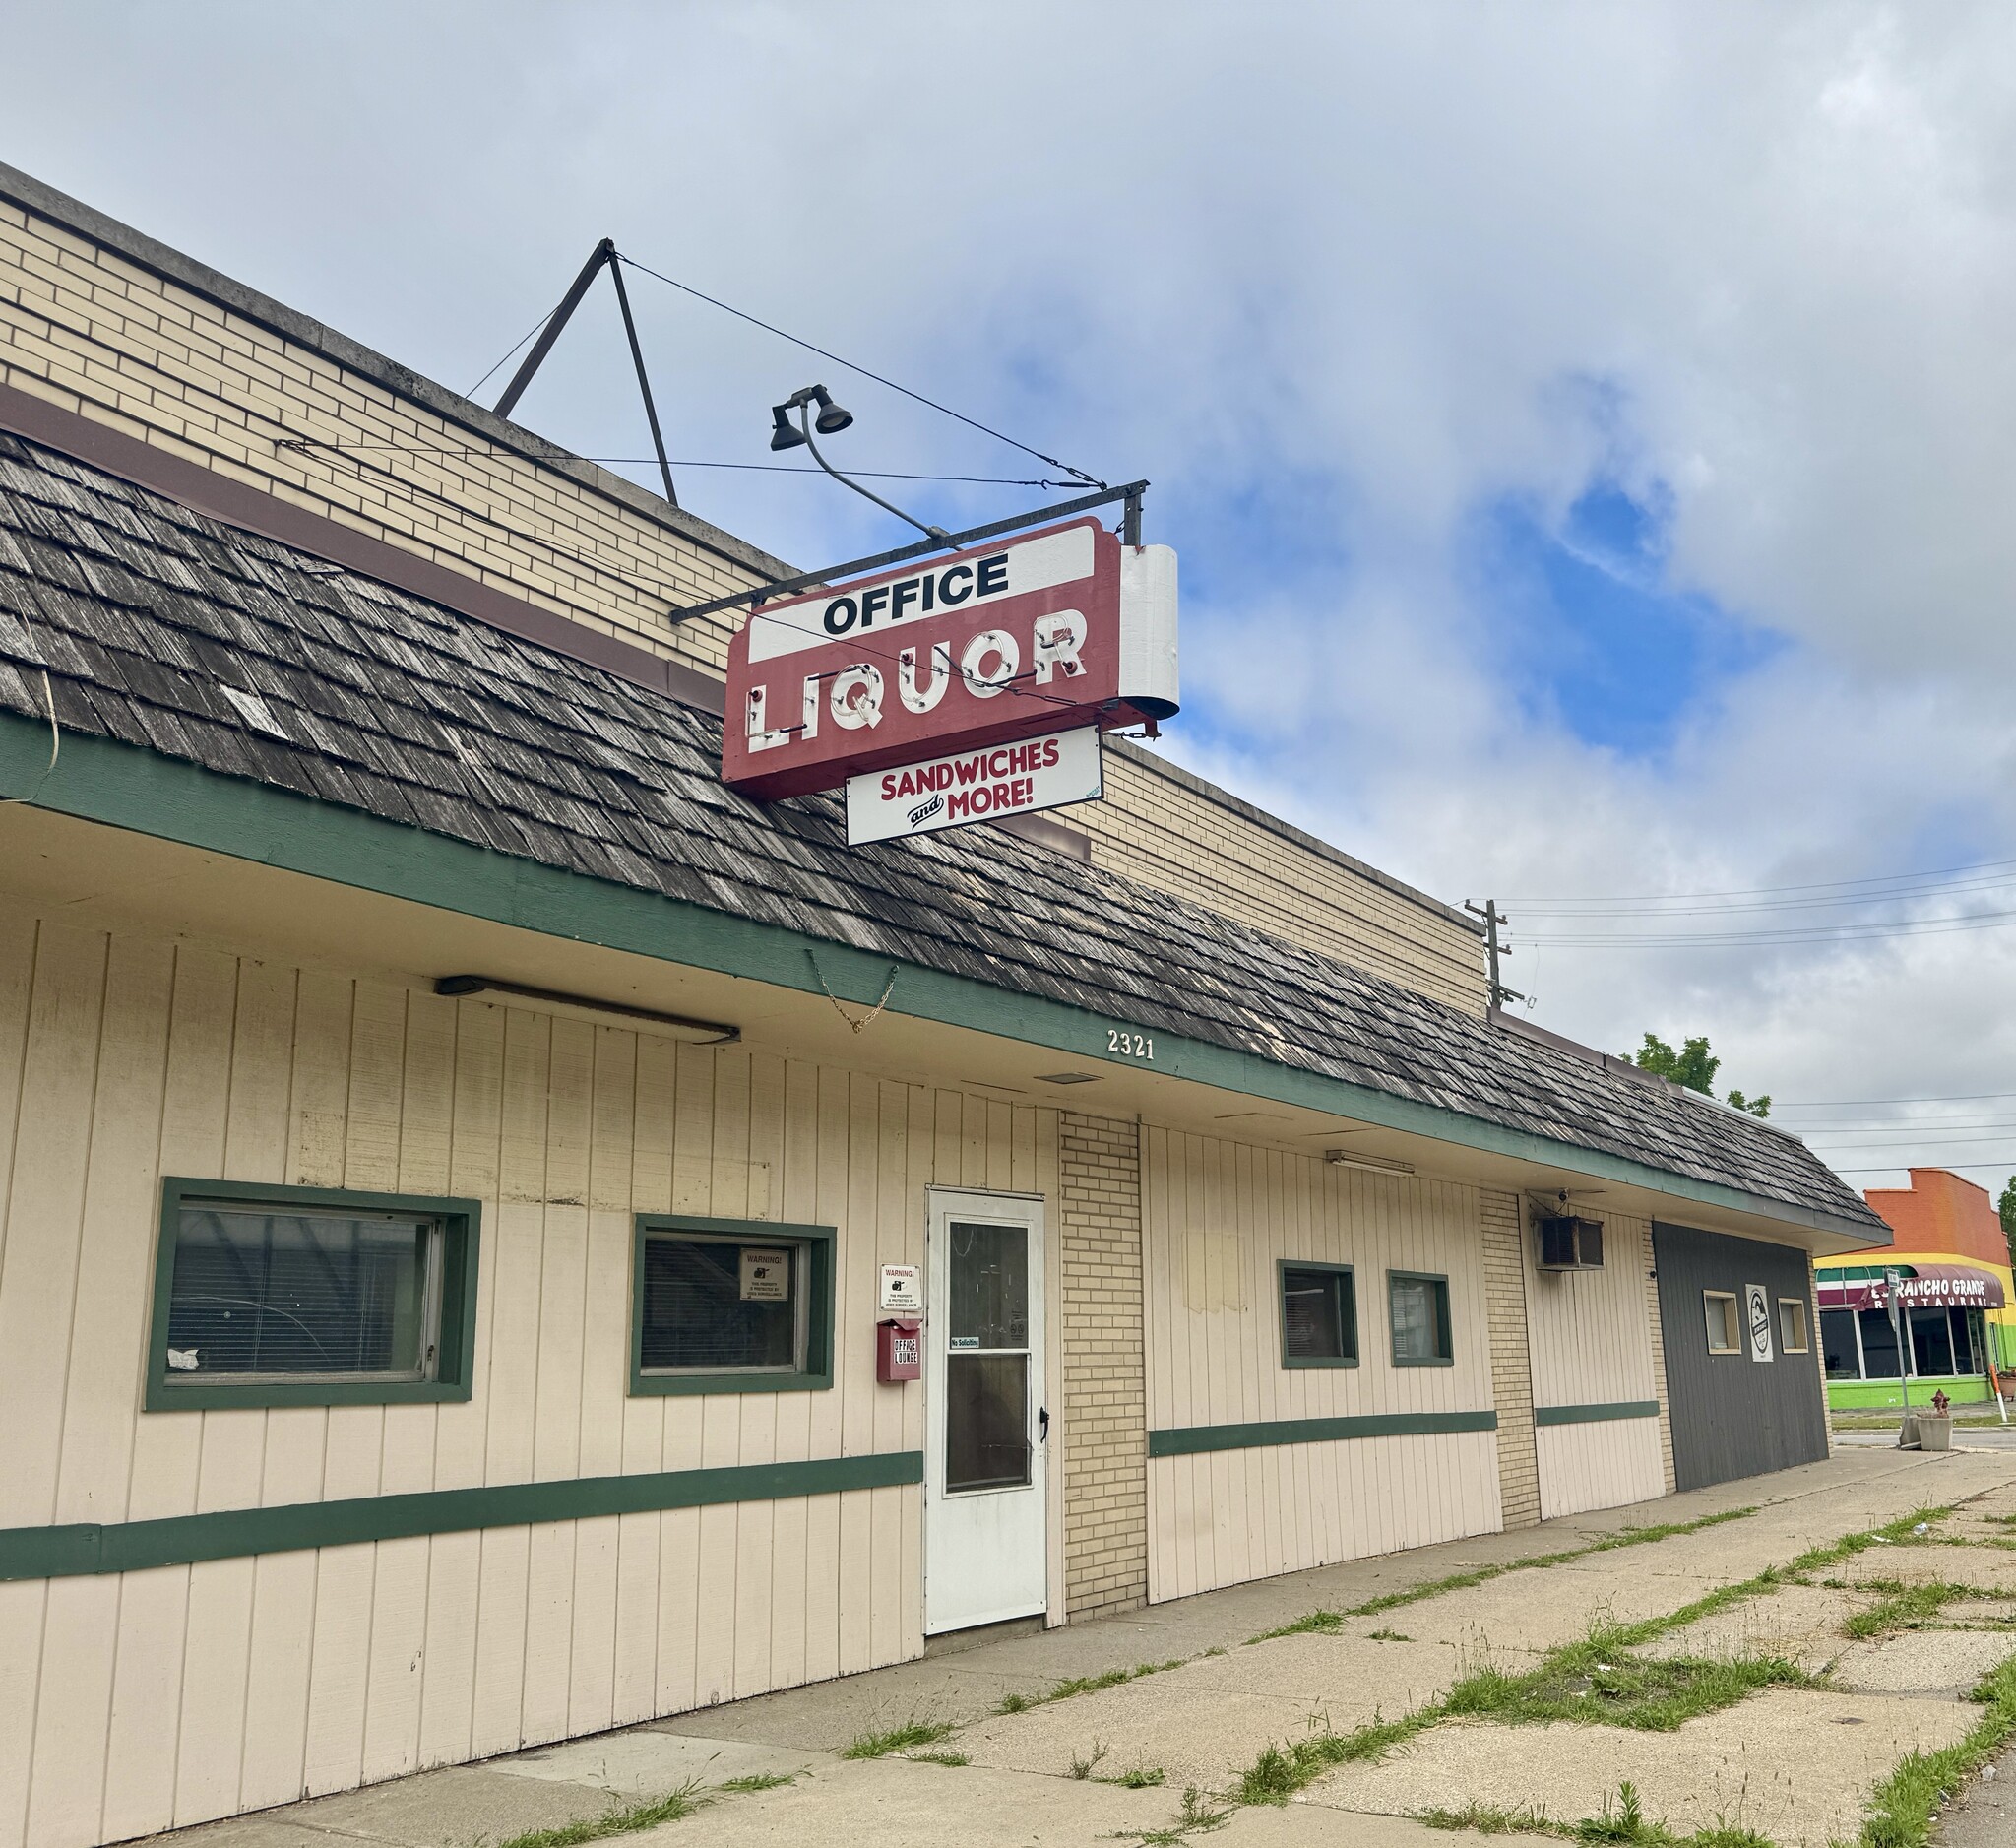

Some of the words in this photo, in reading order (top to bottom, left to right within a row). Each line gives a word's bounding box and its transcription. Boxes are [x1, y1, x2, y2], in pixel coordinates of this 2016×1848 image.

[823, 554, 1009, 635] OFFICE
[746, 608, 1089, 754] LIQUOR
[880, 738, 1060, 801] SANDWICHES
[948, 777, 1034, 820] MORE!
[907, 794, 944, 828] and
[1107, 1029, 1154, 1060] 2321
[747, 1255, 782, 1264] WARNING!
[885, 1269, 914, 1278] WARNING!
[1895, 1279, 1949, 1298] RANCHO
[1952, 1279, 1985, 1297] GRANDE
[1874, 1297, 1987, 1308] RSTAURANT
[895, 1340, 915, 1351] OFFICE
[958, 1339, 978, 1348] Soliciting
[895, 1352, 917, 1363] LOUNGE
